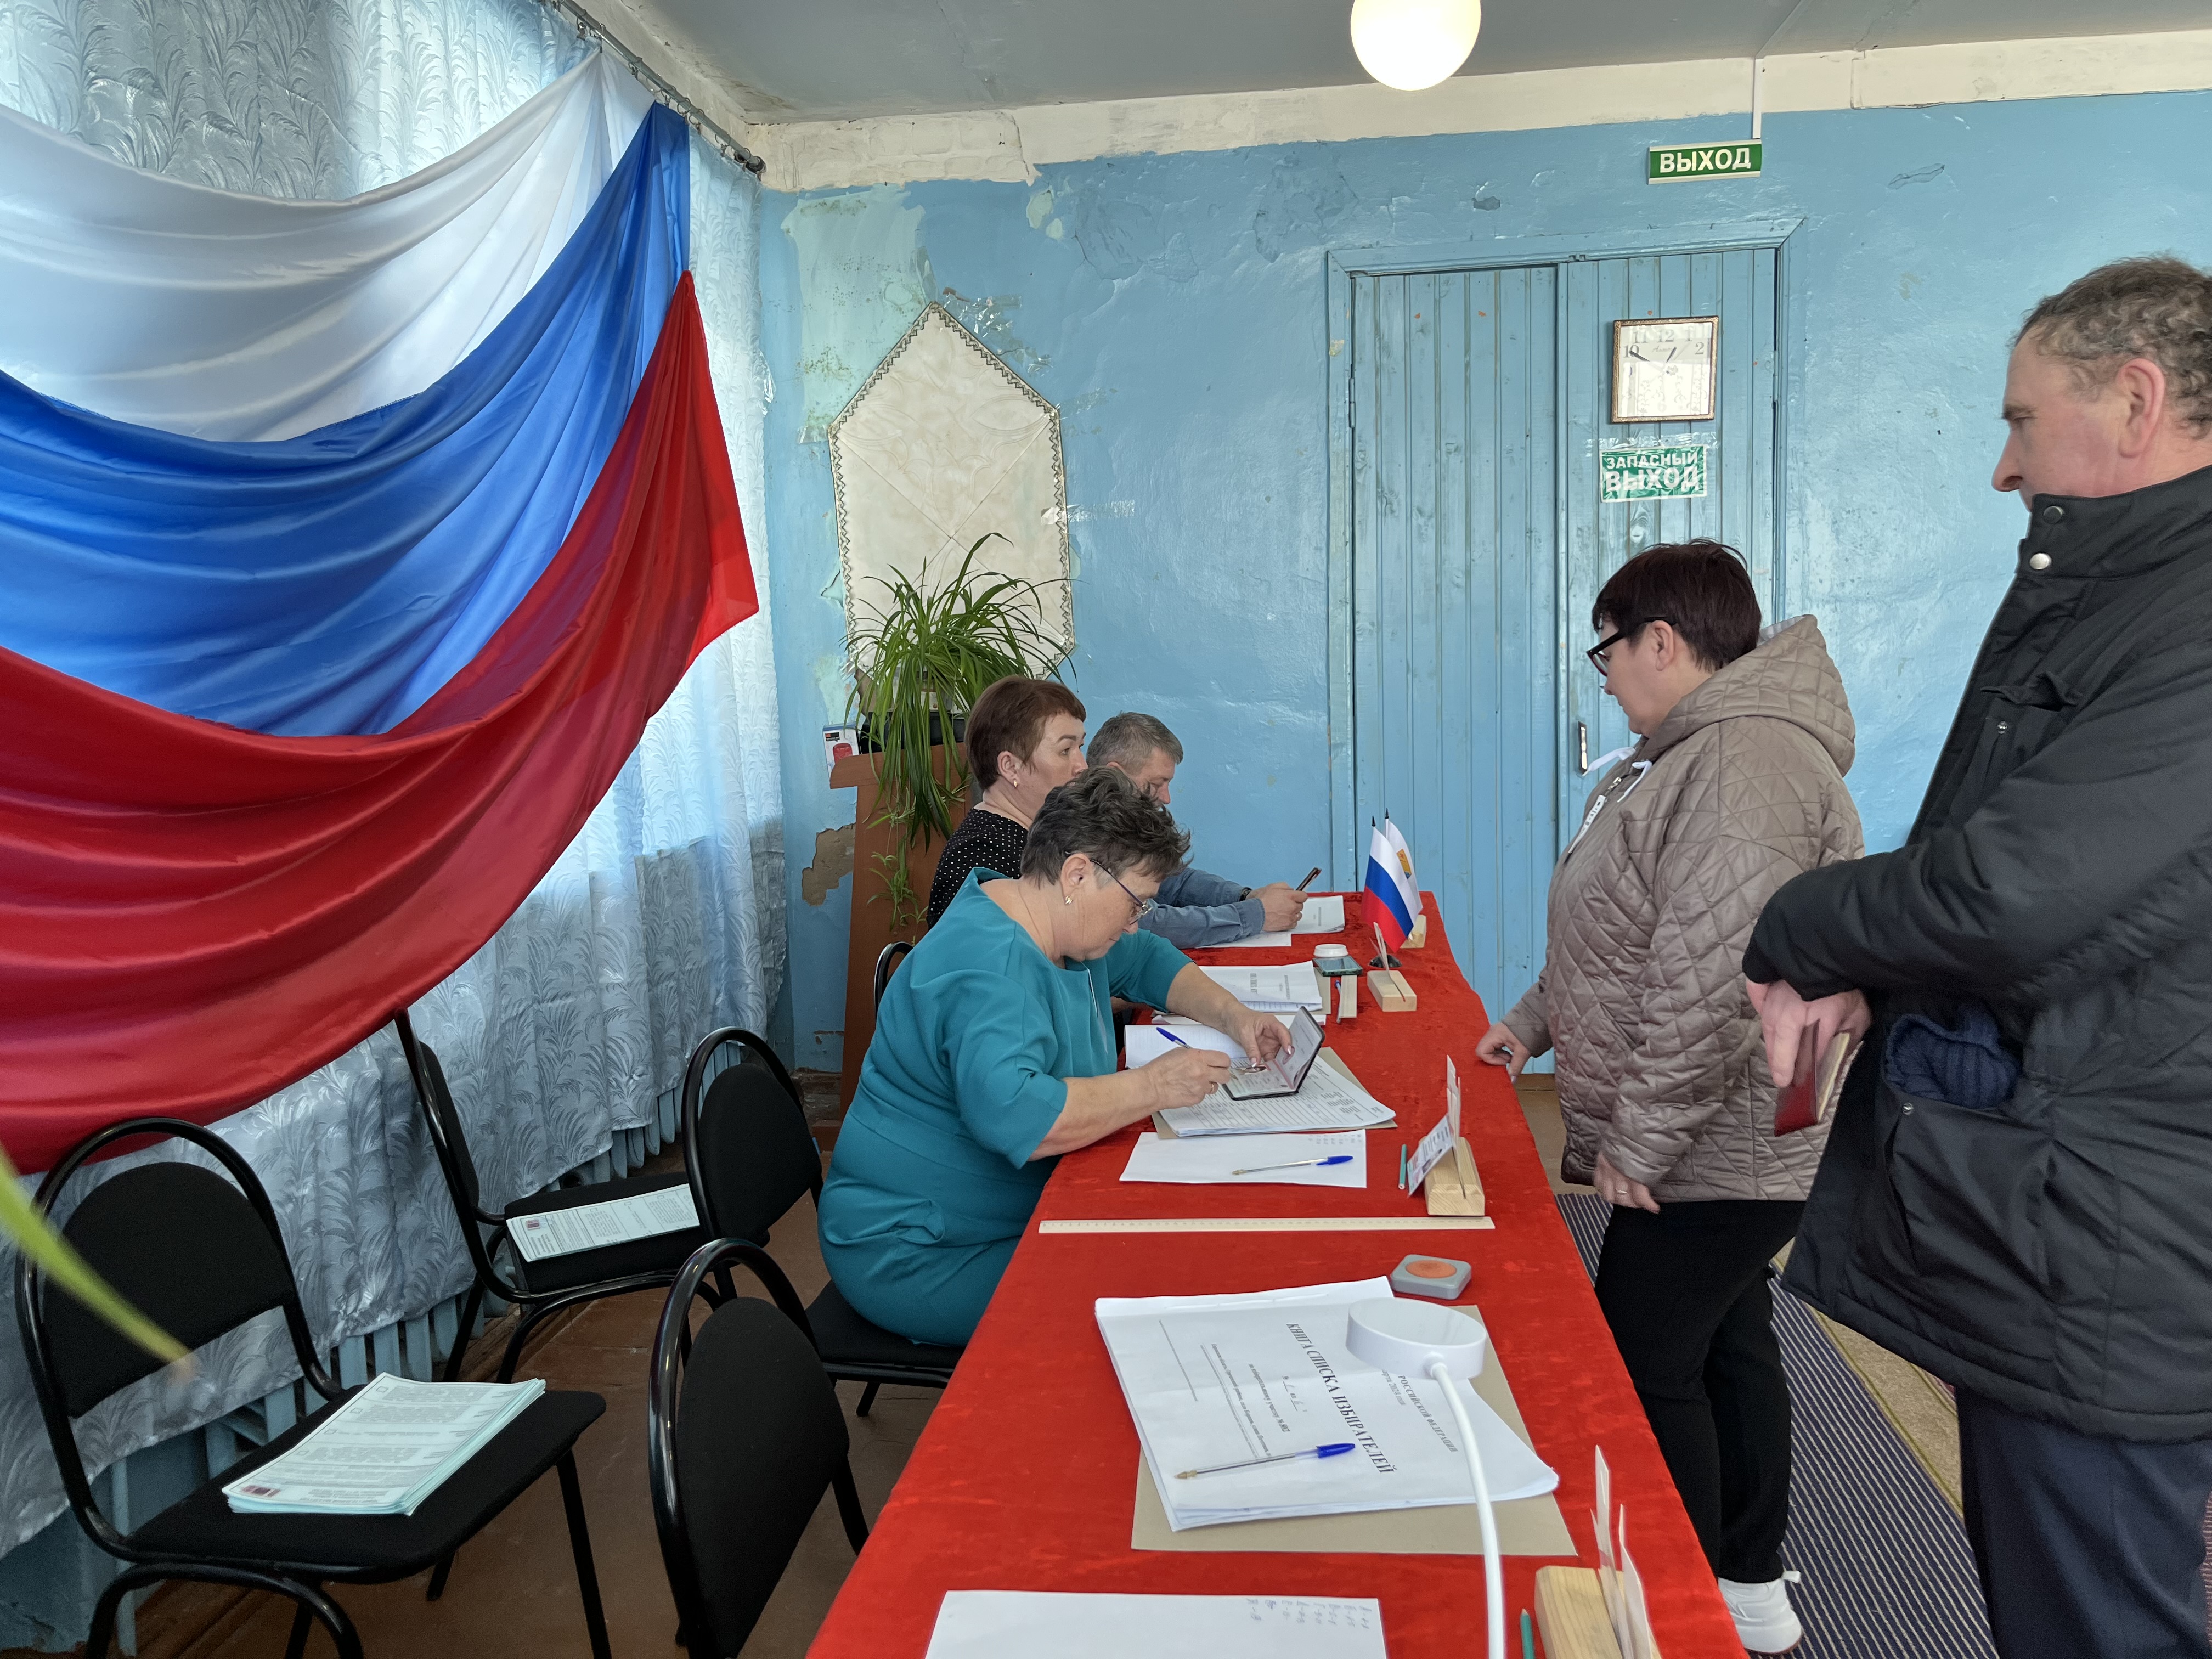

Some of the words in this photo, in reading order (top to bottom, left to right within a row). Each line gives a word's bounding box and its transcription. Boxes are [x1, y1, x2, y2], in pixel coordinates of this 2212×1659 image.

[1660, 148, 1752, 173] ВЫХОД
[1632, 331, 1648, 344] 11
[1656, 329, 1674, 343] 12
[1623, 345, 1639, 358] 10
[1695, 342, 1705, 354] 2
[1606, 448, 1699, 469] ЗАПАСНЫЙ
[1605, 466, 1700, 492] ВЫХОД
[1286, 1323, 1314, 1349] КНИГА
[1306, 1350, 1340, 1392] СПИСКА
[1331, 1396, 1397, 1473] ИЗБИРАТЕЛЕЙ
[1389, 1383, 1401, 1395] 2024
[1398, 1375, 1432, 1418] РОССИЙСКОЙ
[1427, 1418, 1459, 1452] ФЕДЕРАЦИИ
